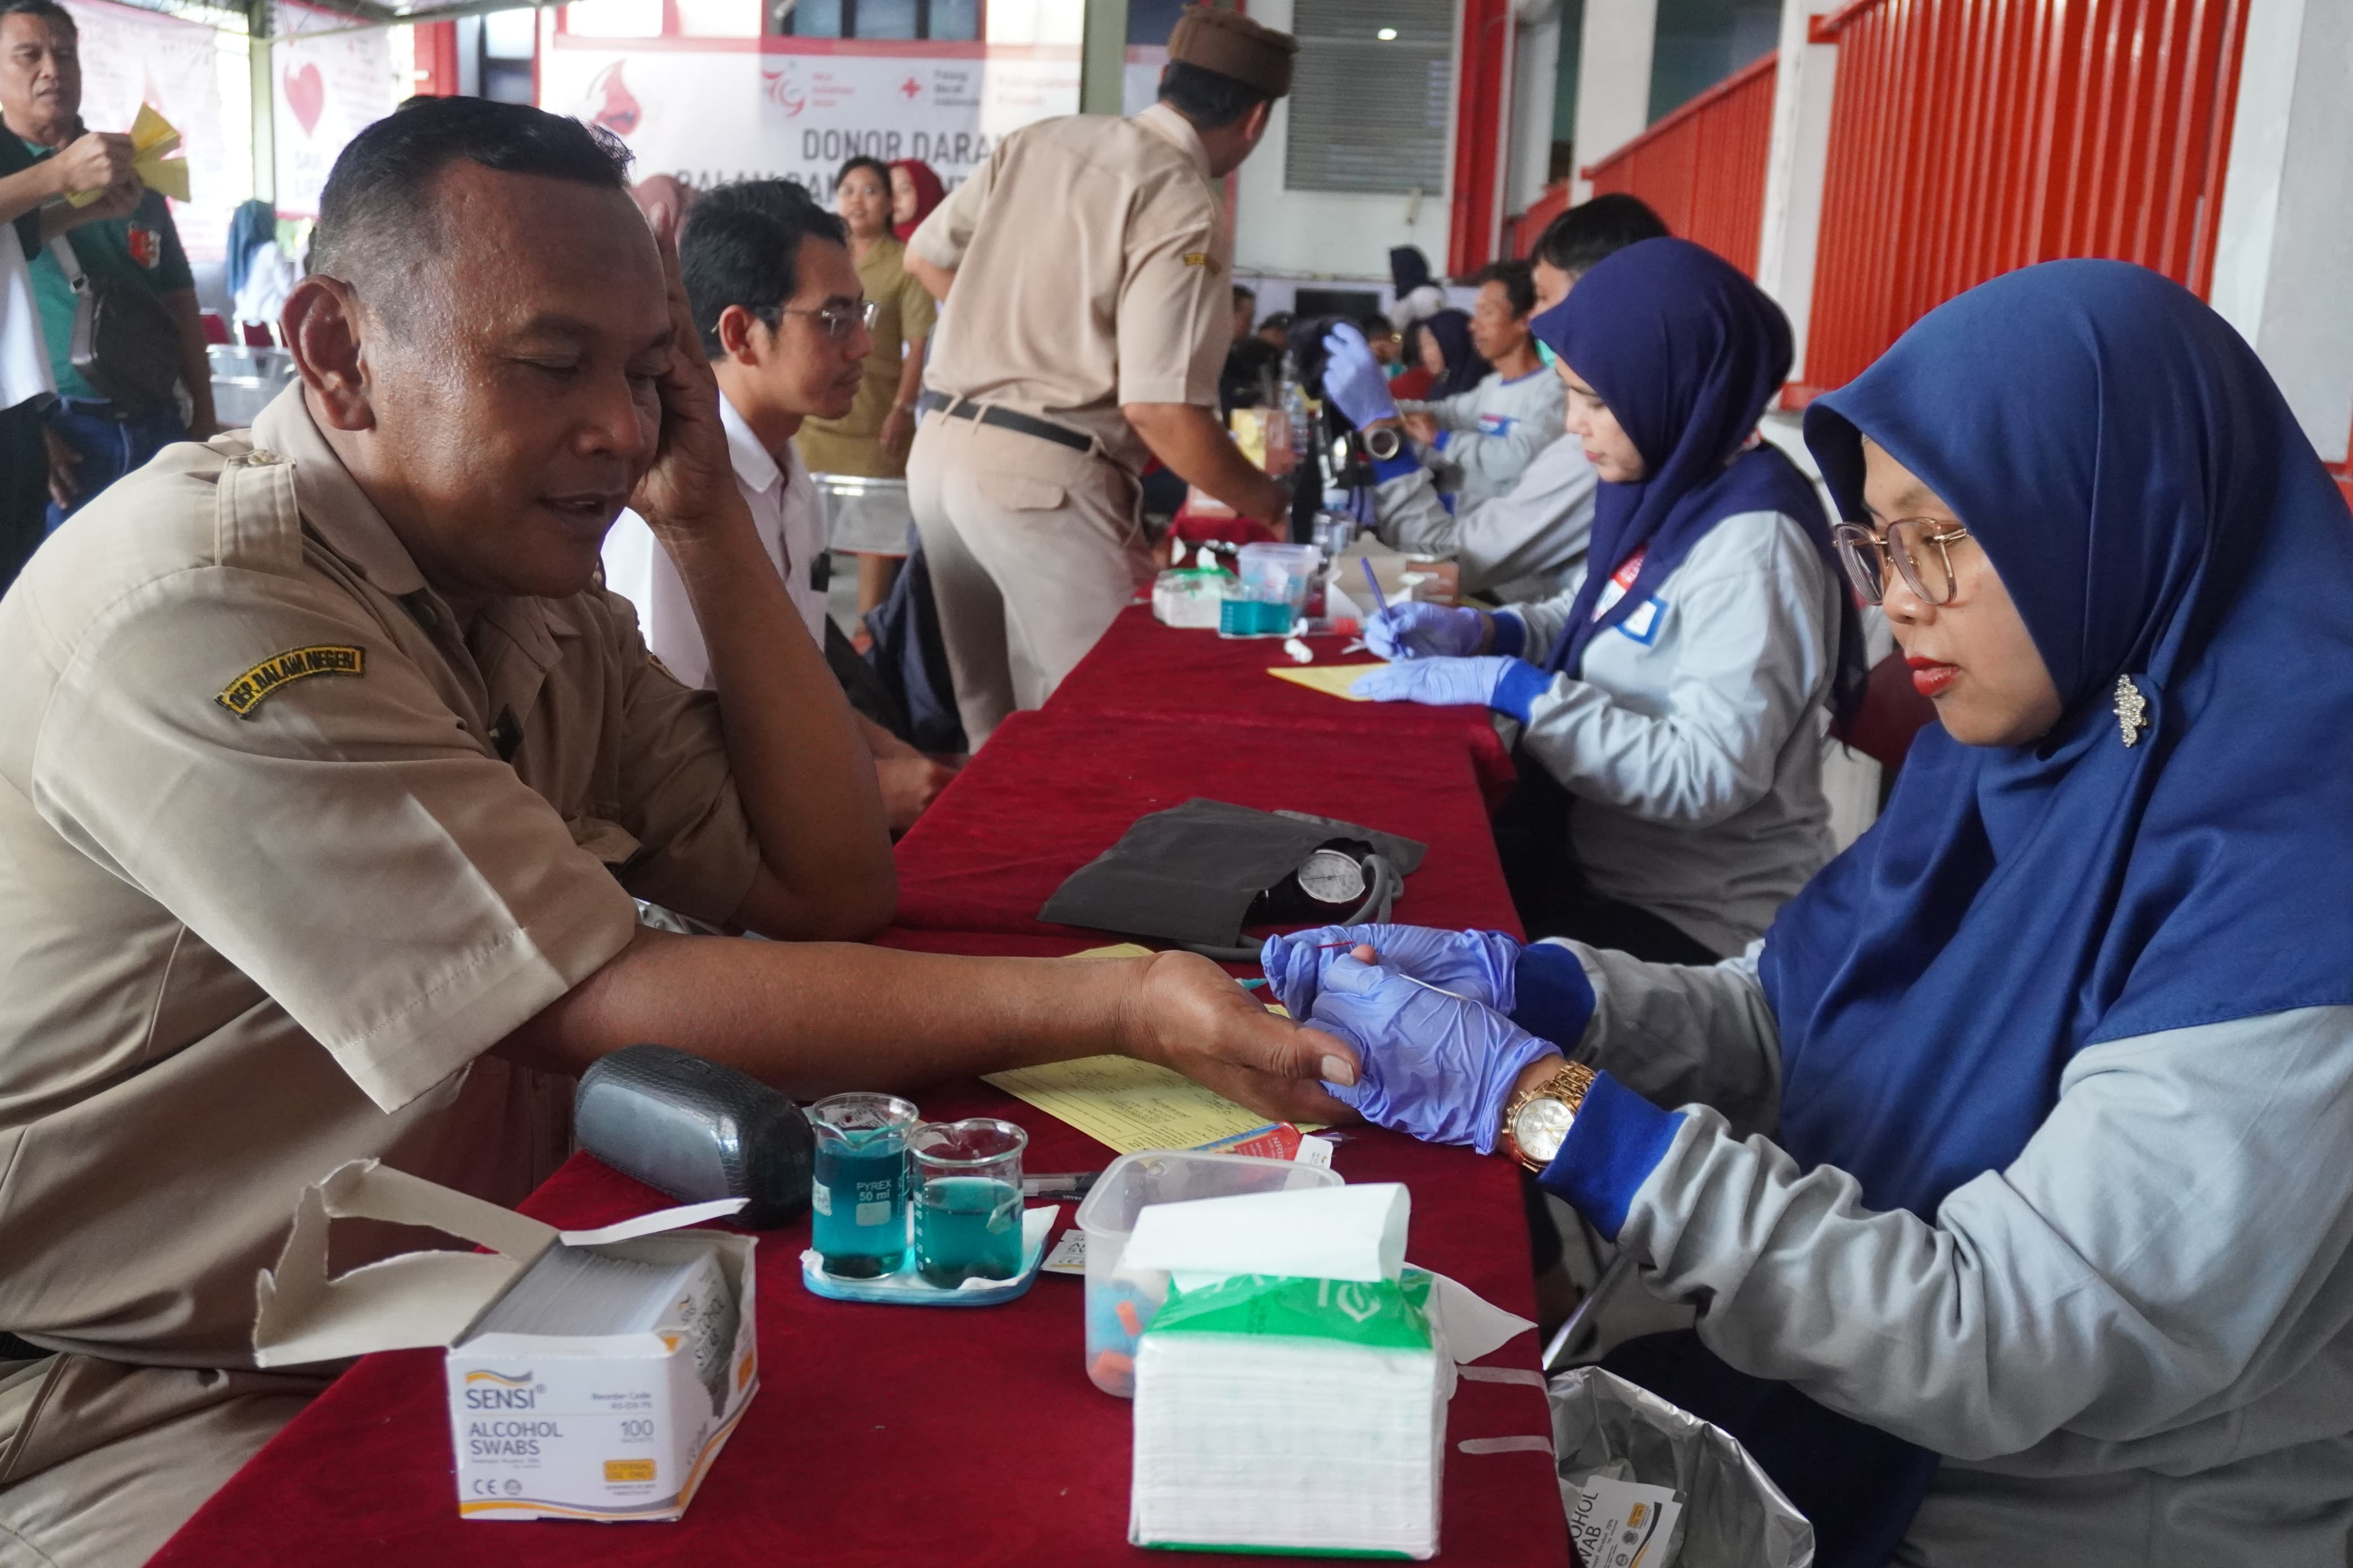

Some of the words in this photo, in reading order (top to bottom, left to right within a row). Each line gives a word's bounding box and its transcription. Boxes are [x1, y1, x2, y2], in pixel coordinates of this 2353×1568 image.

[803, 128, 901, 161] DONOR
[912, 131, 1002, 164] DARA
[856, 1179, 892, 1191] PYREX
[860, 1191, 873, 1202] 50
[876, 1188, 890, 1200] ml
[469, 1421, 563, 1438] ALCOHOL
[620, 1419, 654, 1437] 100
[469, 1439, 540, 1455] SWABS
[1572, 1492, 1599, 1543] OHOL
[1578, 1525, 1601, 1565] WAB
